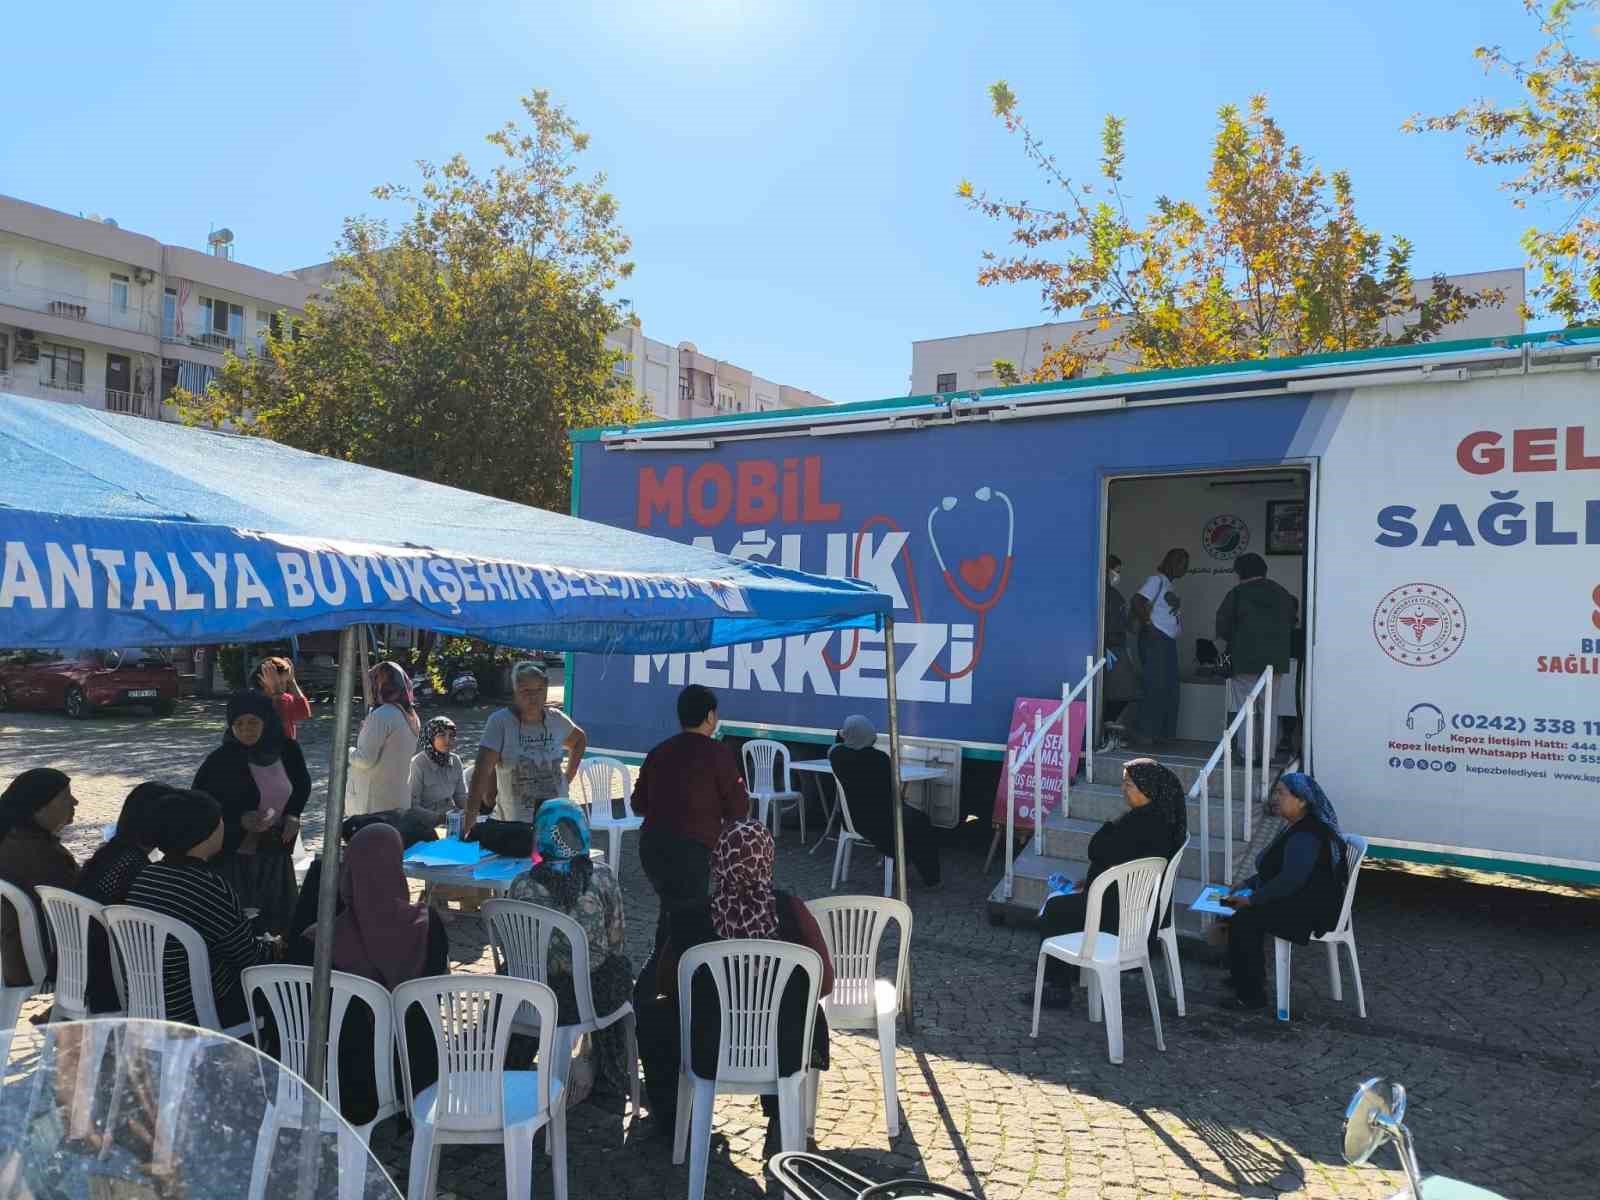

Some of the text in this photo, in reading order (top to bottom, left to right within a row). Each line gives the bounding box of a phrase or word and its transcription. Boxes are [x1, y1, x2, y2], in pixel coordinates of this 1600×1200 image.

[1456, 426, 1600, 475] GEL
[1, 541, 274, 610] ANTALYA
[1452, 713, 1526, 733] (0242)
[1534, 718, 1575, 735] 338
[1388, 741, 1422, 751] Kepez
[1468, 747, 1527, 759] Whatsapp
[1568, 753, 1576, 762] 0
[1450, 733, 1485, 745] Kepez
[1571, 741, 1597, 751] 444
[1466, 764, 1547, 778] kepezbelediyesi
